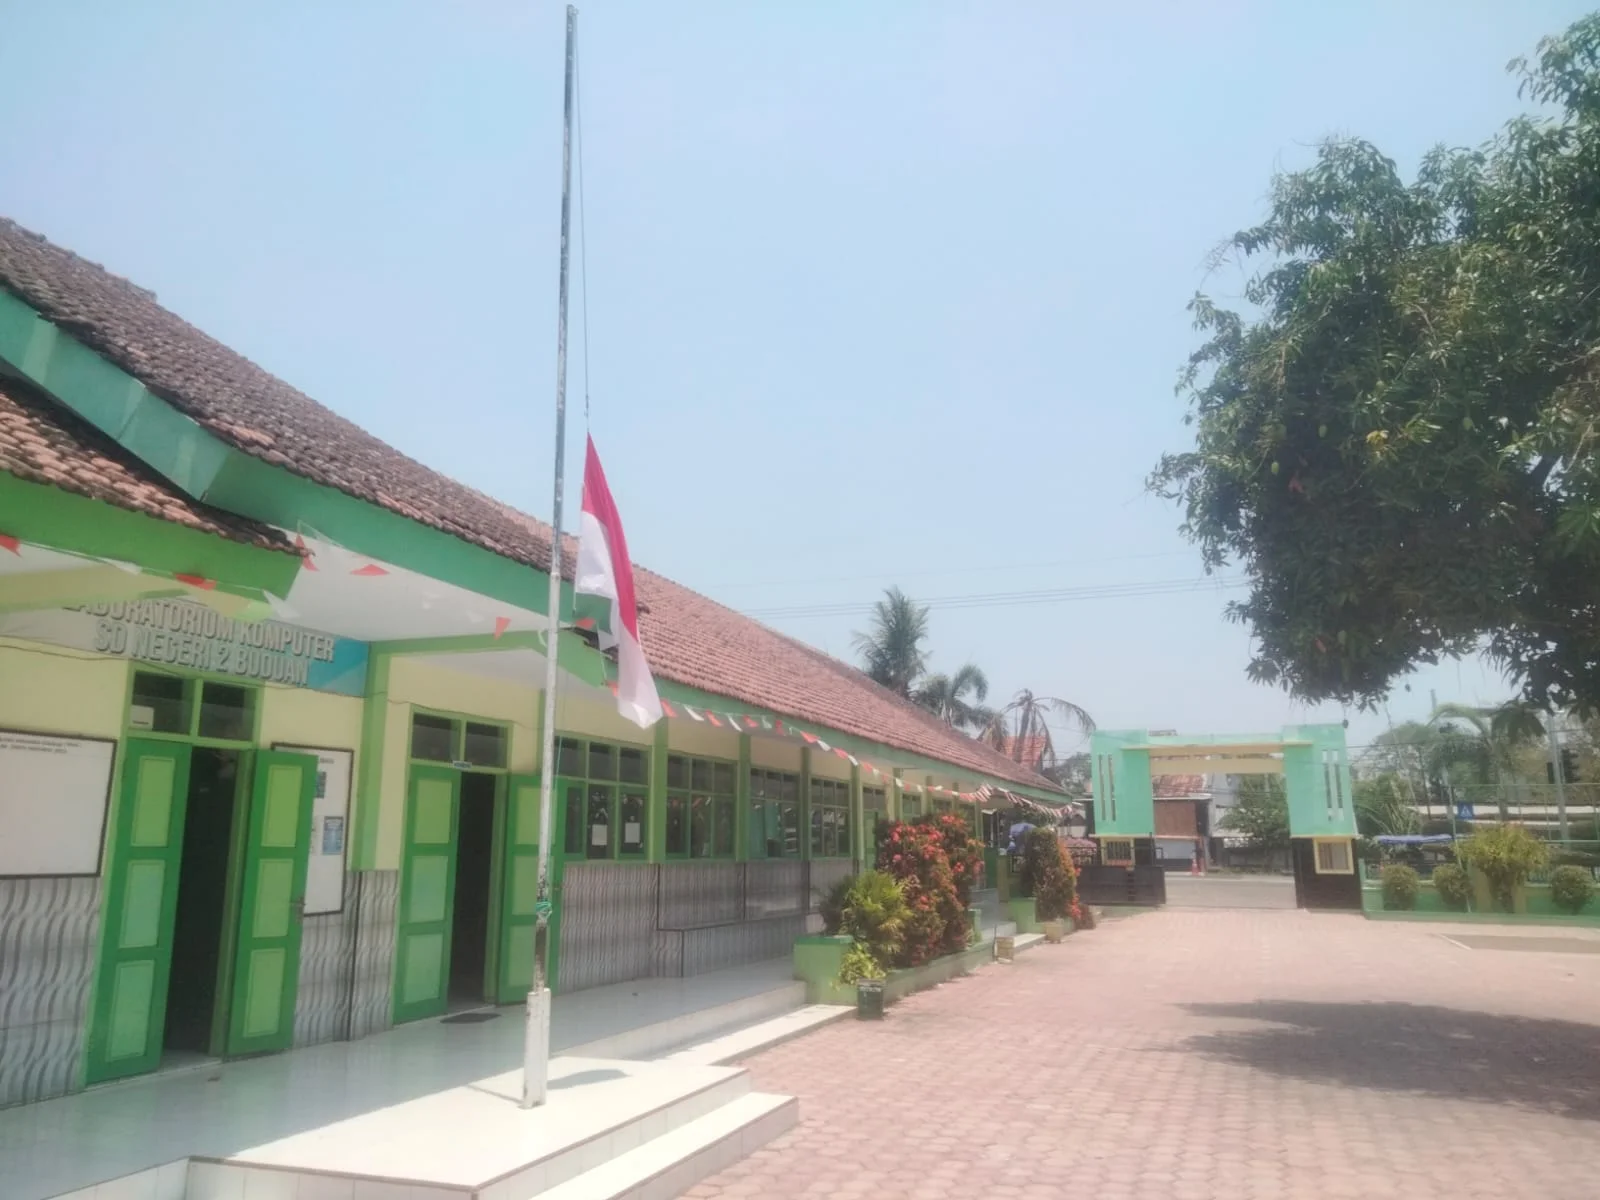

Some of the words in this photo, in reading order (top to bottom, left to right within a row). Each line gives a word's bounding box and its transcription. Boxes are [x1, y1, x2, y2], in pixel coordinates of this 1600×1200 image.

[62, 599, 235, 643] BORATORIUM
[240, 621, 335, 664] KOMPUTER
[95, 619, 128, 654] SD
[131, 624, 213, 670] NEGERI
[216, 647, 229, 672] 2
[235, 649, 308, 686] BUDUAN
